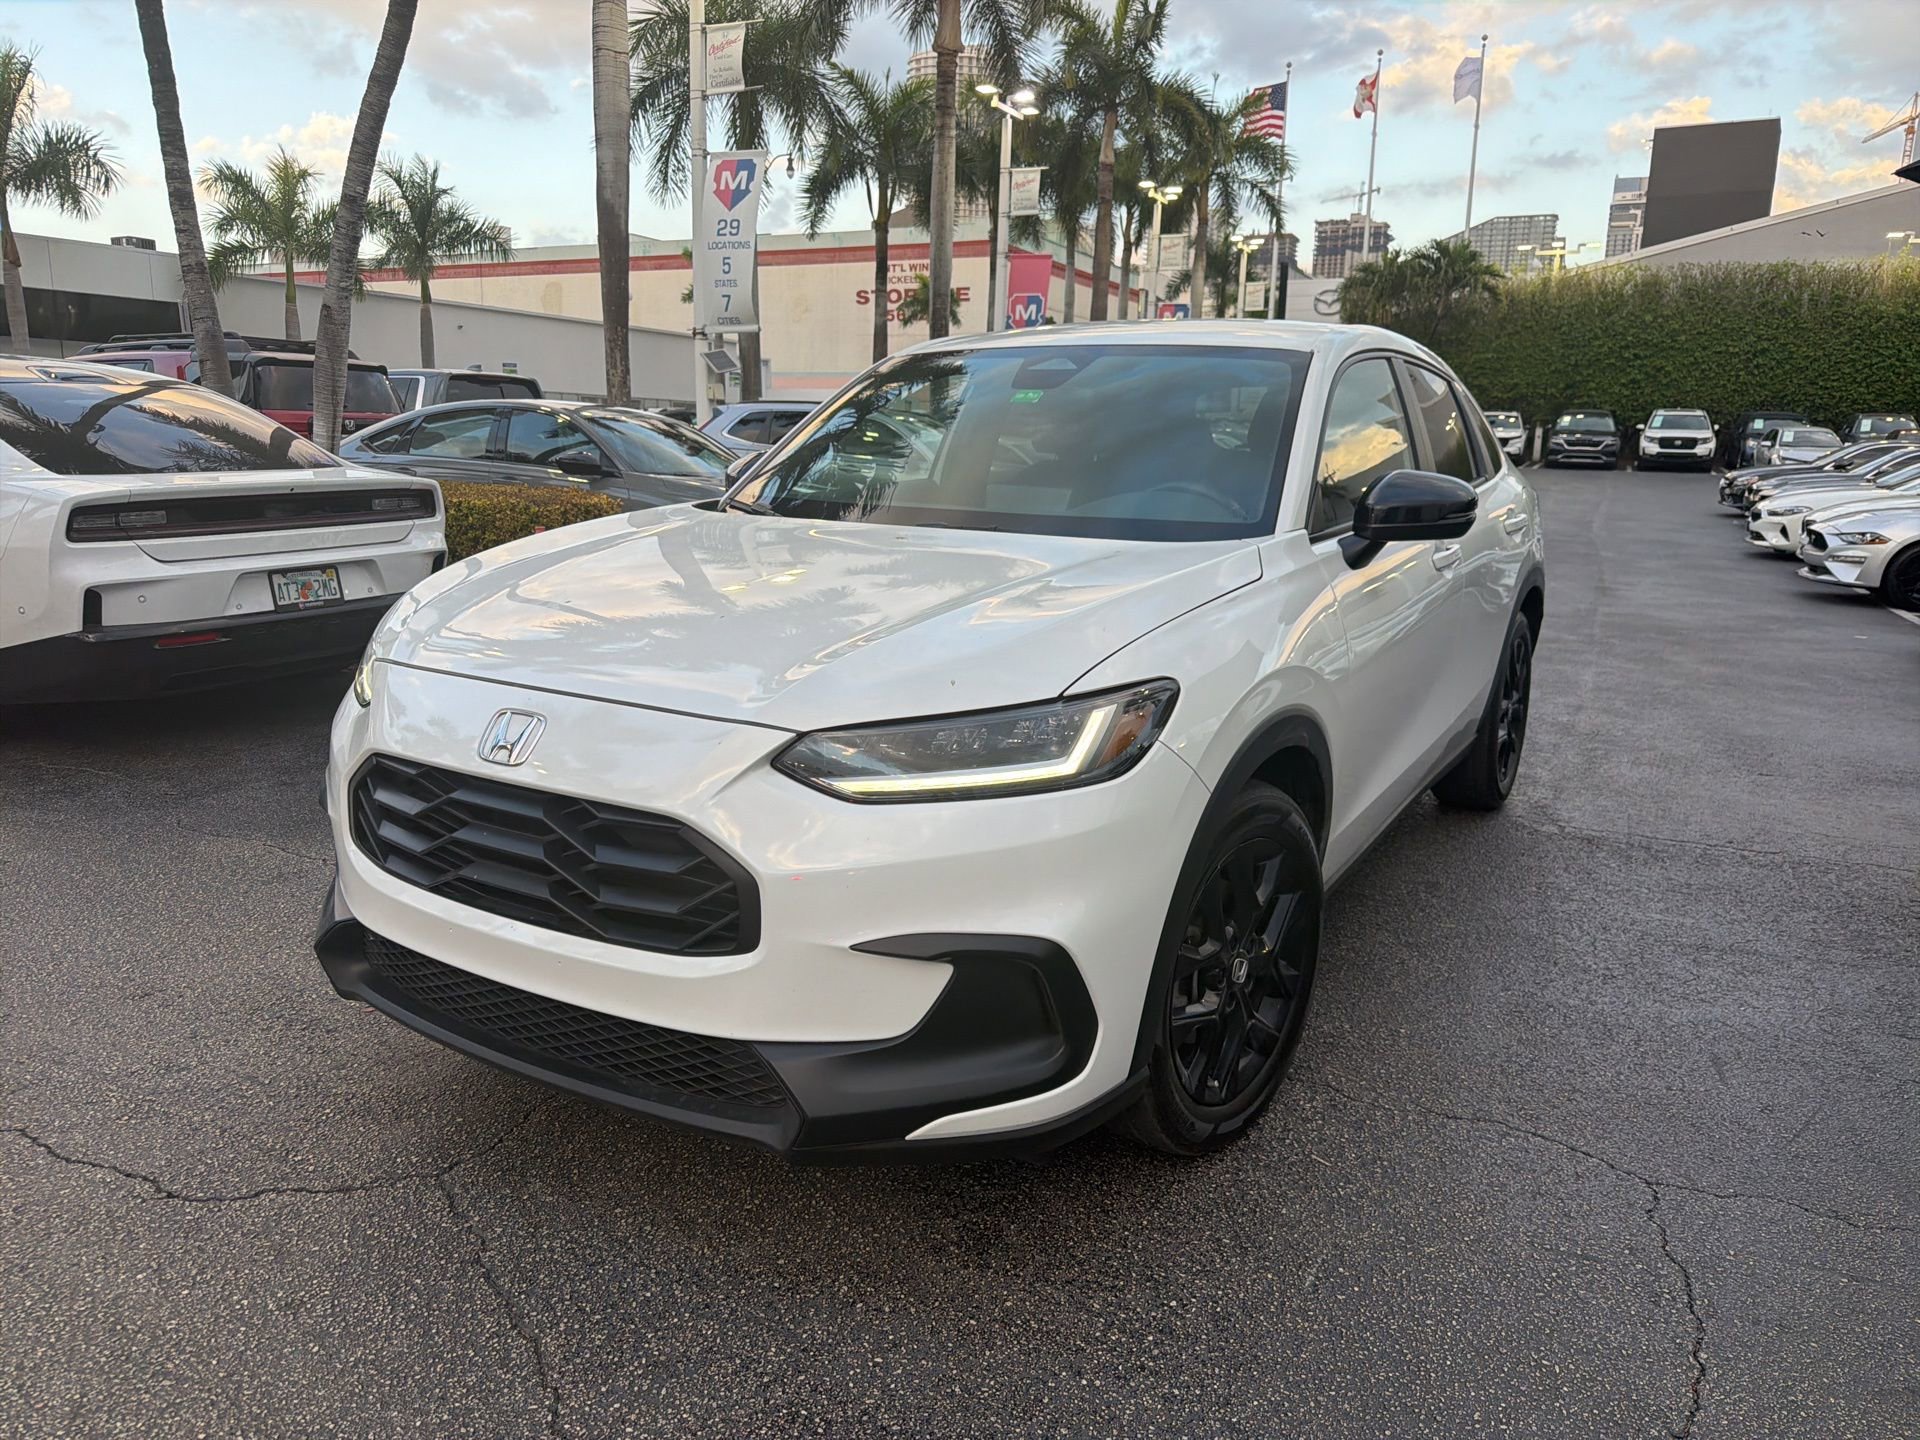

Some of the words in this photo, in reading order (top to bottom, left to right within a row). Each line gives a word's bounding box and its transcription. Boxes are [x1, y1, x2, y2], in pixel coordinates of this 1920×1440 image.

[720, 170, 749, 190] M
[716, 218, 741, 237] 29
[707, 241, 751, 250] LOCATIONS
[722, 256, 732, 274] 5
[714, 279, 738, 288] STATES
[721, 294, 732, 313] 7
[1015, 303, 1037, 321] M
[717, 317, 742, 325] CITIES
